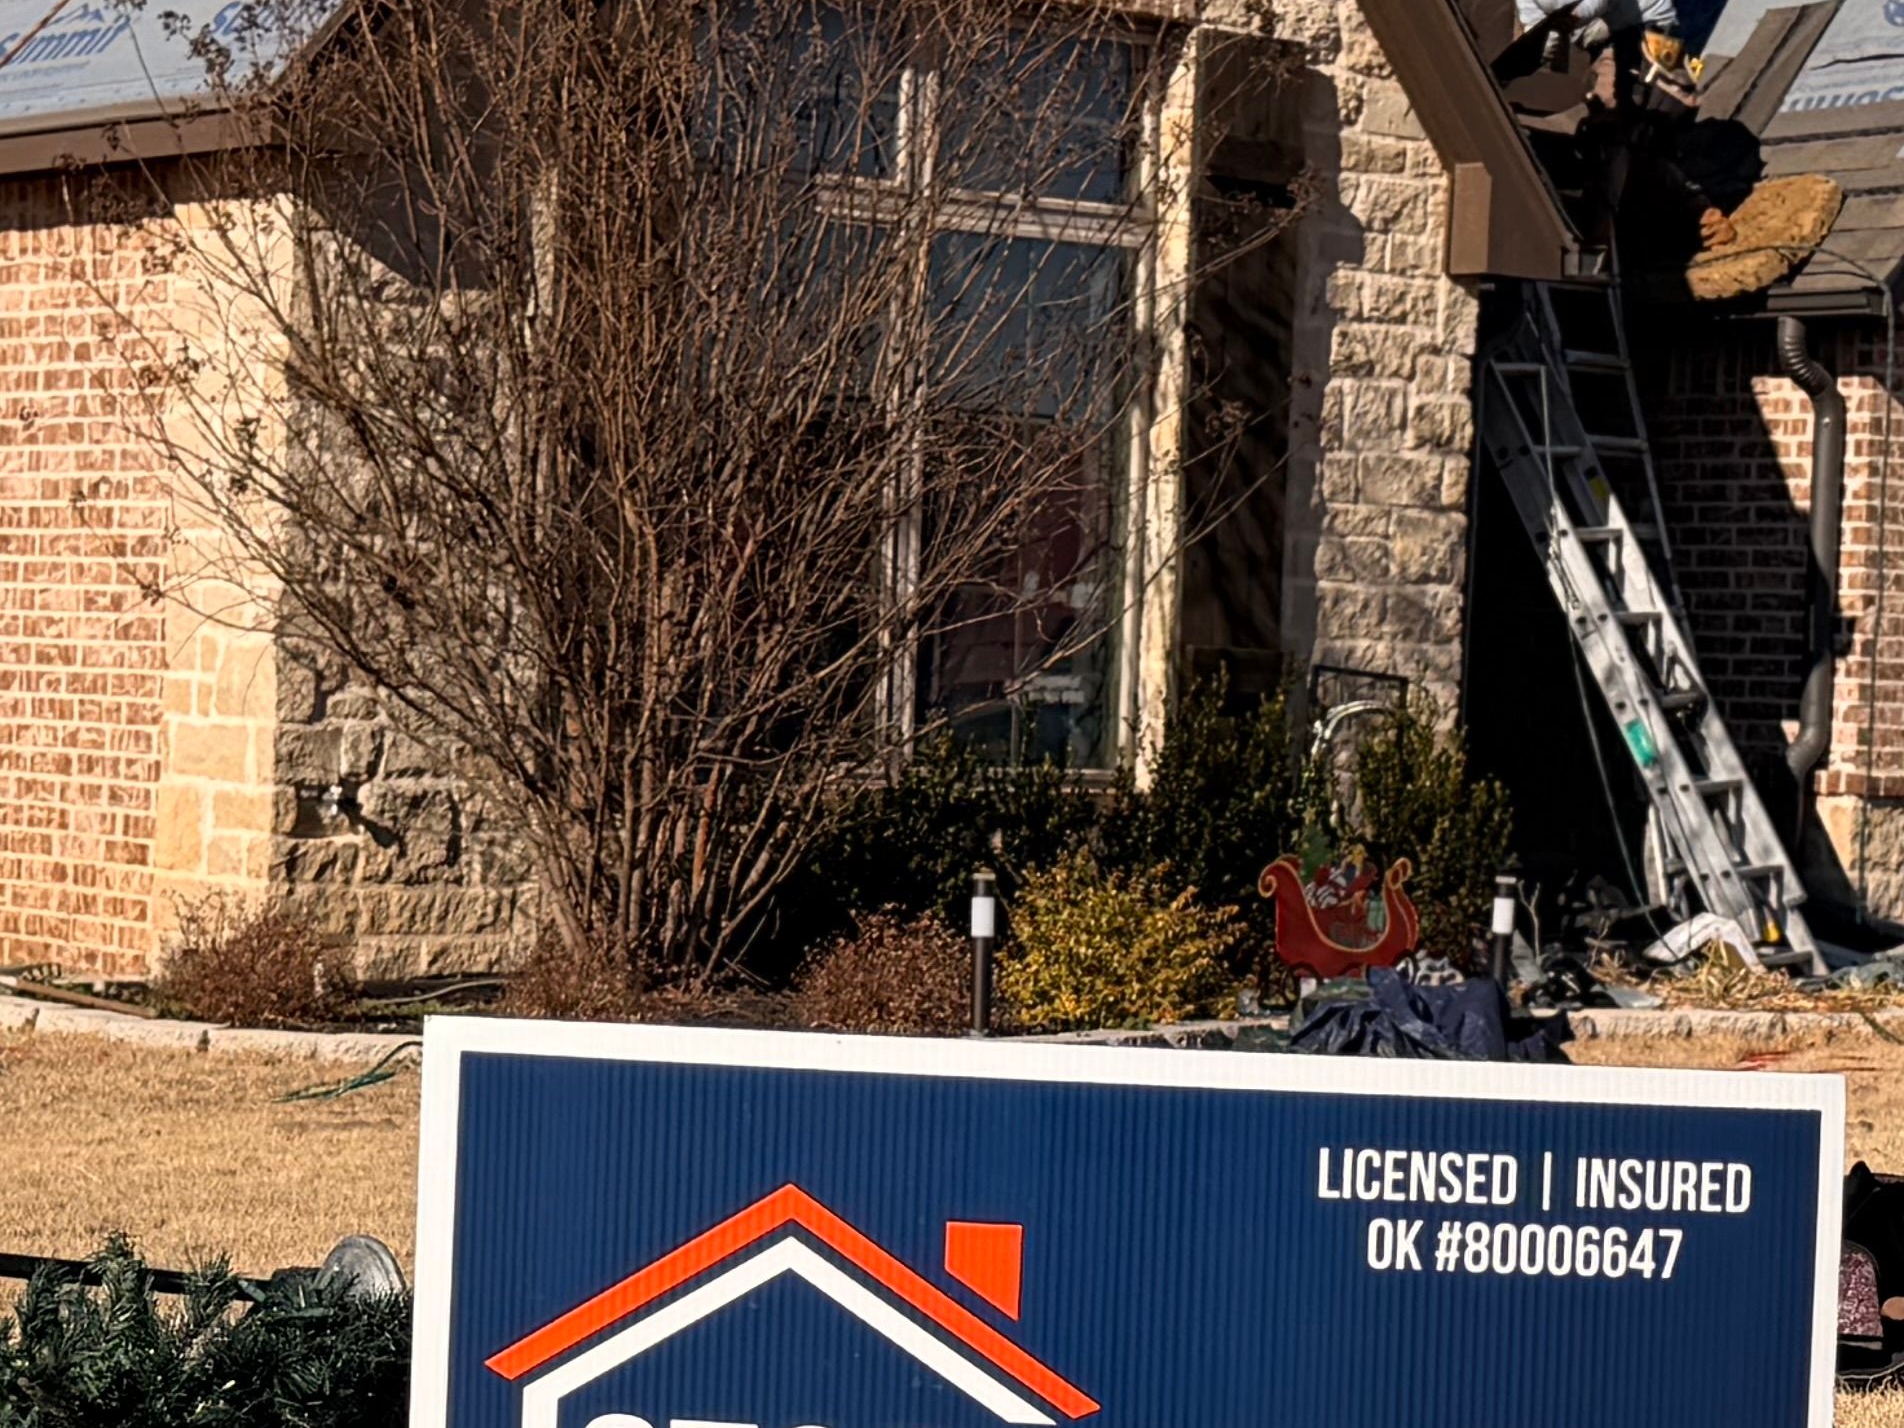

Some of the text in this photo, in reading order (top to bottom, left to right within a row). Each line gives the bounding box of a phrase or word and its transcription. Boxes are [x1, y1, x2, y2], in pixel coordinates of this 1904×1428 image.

[1319, 1147, 1517, 1205] LICENSED
[1576, 1157, 1752, 1213] INSURED
[1368, 1218, 1683, 1279] OK #80006647
